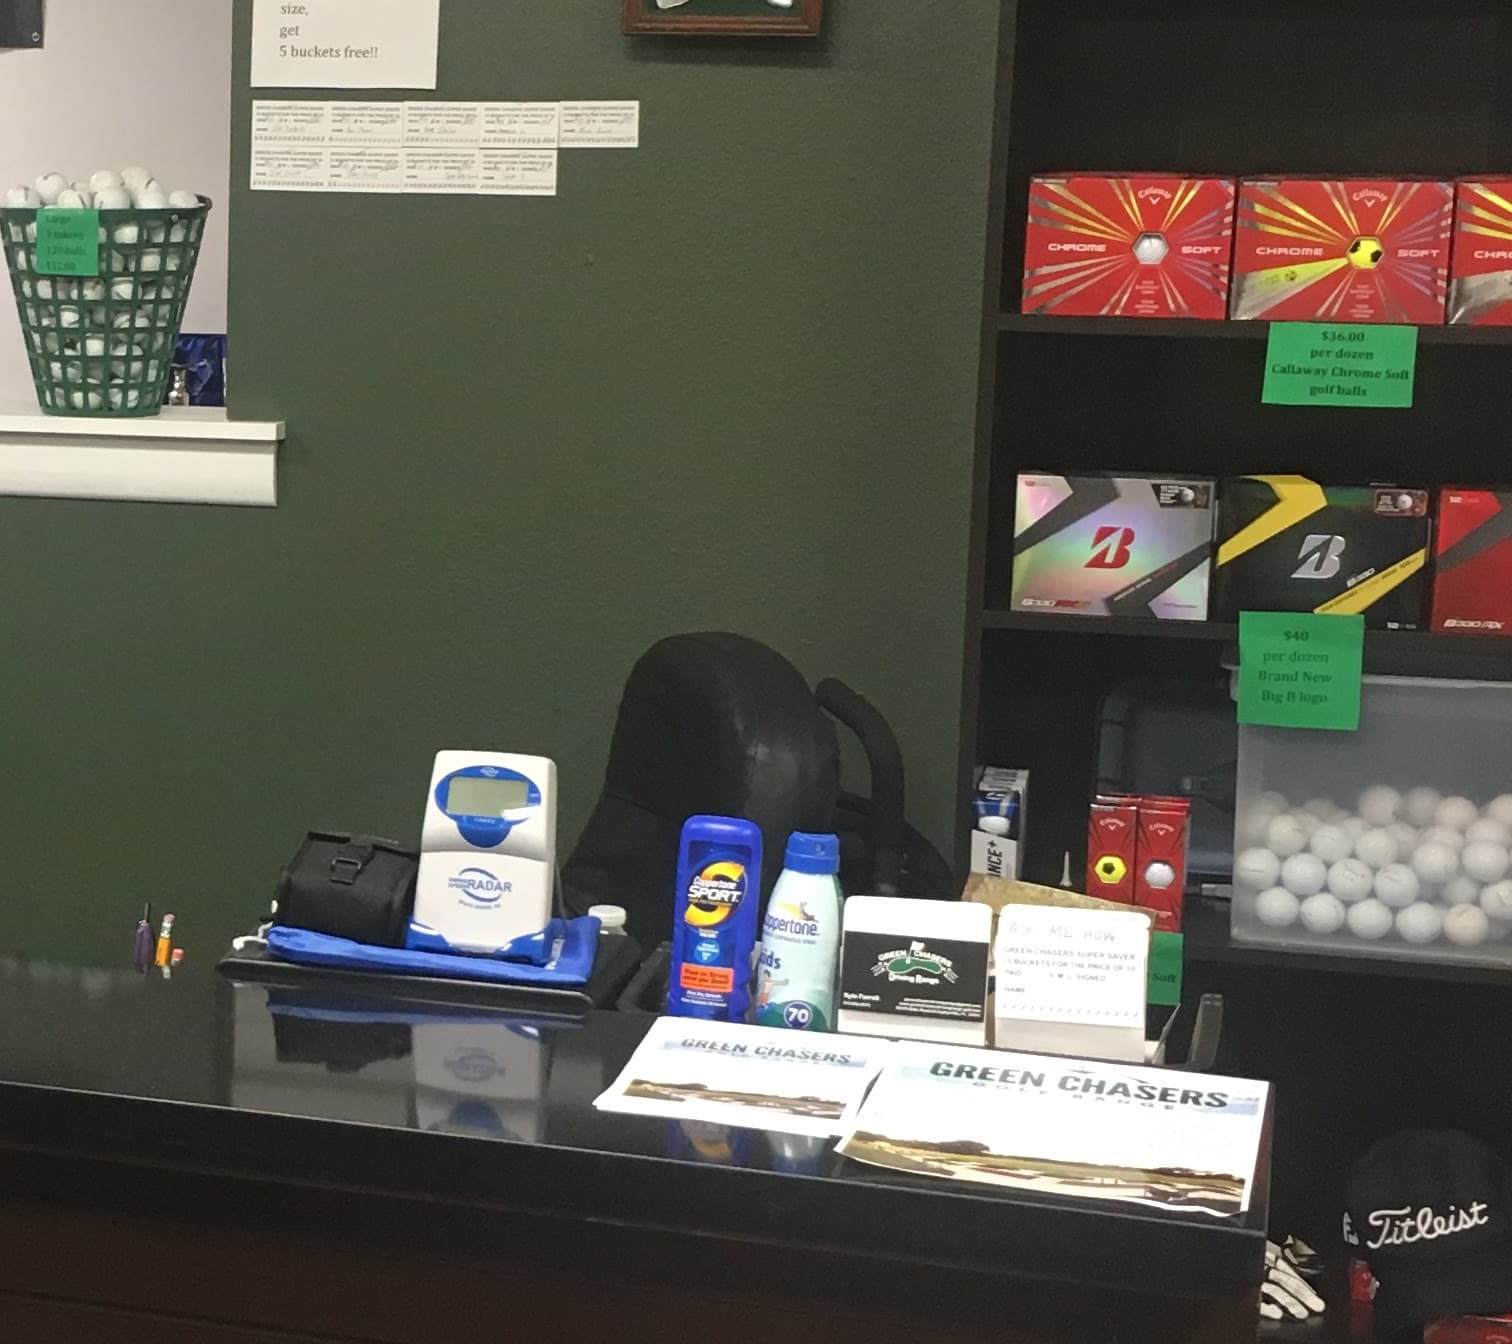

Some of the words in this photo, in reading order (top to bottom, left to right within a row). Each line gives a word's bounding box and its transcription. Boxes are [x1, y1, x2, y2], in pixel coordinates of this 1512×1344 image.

[279, 24, 300, 39] get
[279, 45, 287, 58] 5
[290, 45, 341, 59] buckets
[343, 45, 379, 59] free!!
[1048, 242, 1107, 253] CHROME
[1181, 245, 1223, 255] SOFT
[1255, 246, 1324, 256] CHROME
[1397, 249, 1441, 259] SOFT
[1321, 330, 1365, 343] $36.00
[1309, 348, 1333, 359] per
[1335, 348, 1374, 360] dozen
[1271, 364, 1328, 378] Callaway
[1331, 367, 1381, 379] Chrome
[1385, 369, 1409, 380] Soft
[1309, 385, 1336, 397] golf
[1337, 385, 1367, 397] balls
[1283, 630, 1309, 641] $40
[1263, 652, 1285, 664] per
[1288, 651, 1329, 663] dozen
[1258, 670, 1298, 682] Brand
[1303, 671, 1332, 683] New
[1262, 690, 1284, 704] Big
[1299, 692, 1328, 706] logo
[467, 879, 512, 893] RADAR
[688, 886, 741, 903] SPORT
[760, 948, 780, 969] ids
[1153, 973, 1176, 983] Soft
[788, 1007, 809, 1023] 70
[680, 1038, 747, 1053] GREEN
[754, 1046, 851, 1064] CHASERS
[929, 1061, 1046, 1087] GREEN
[1058, 1075, 1229, 1107] CHASERS
[1366, 1201, 1489, 1248] Titleist
